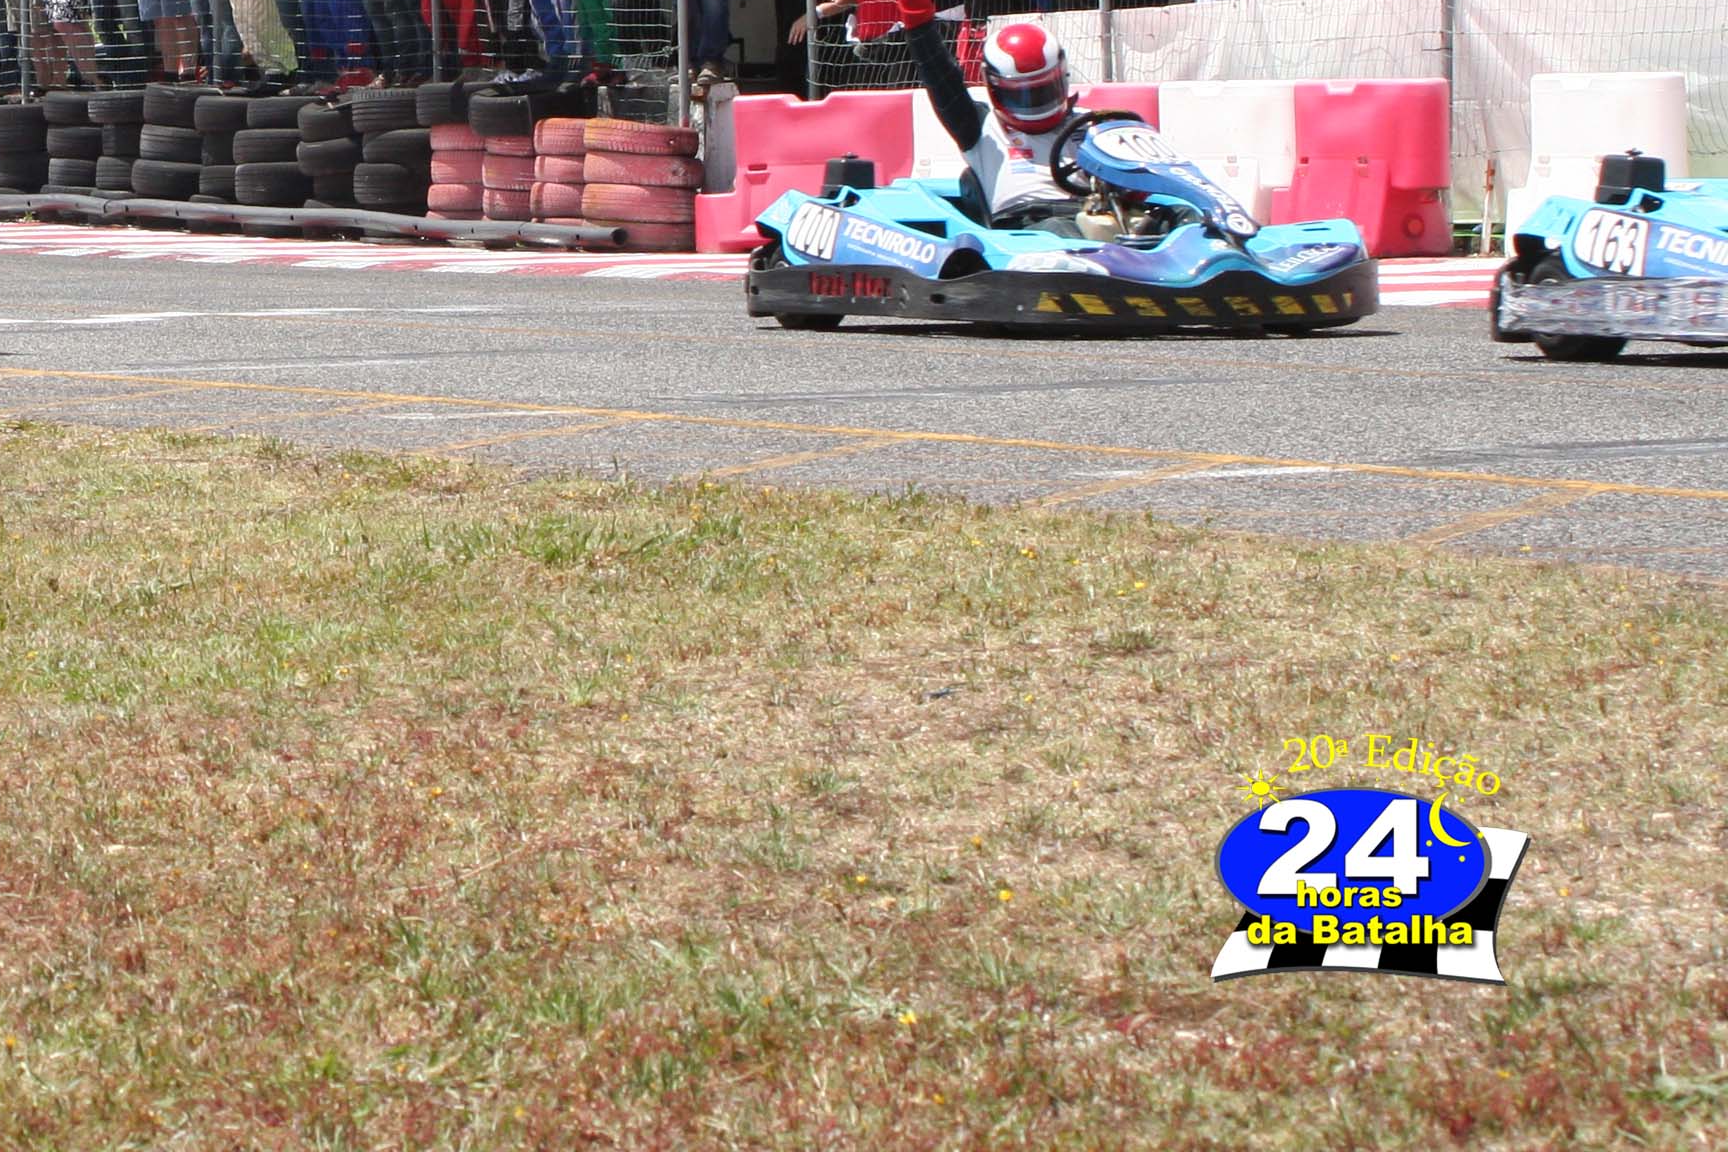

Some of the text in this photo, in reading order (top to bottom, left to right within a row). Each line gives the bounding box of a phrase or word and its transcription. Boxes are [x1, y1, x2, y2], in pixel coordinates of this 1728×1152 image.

[1118, 134, 1177, 161] 100
[843, 217, 937, 265] TECNIROLO
[1589, 214, 1640, 276] 163
